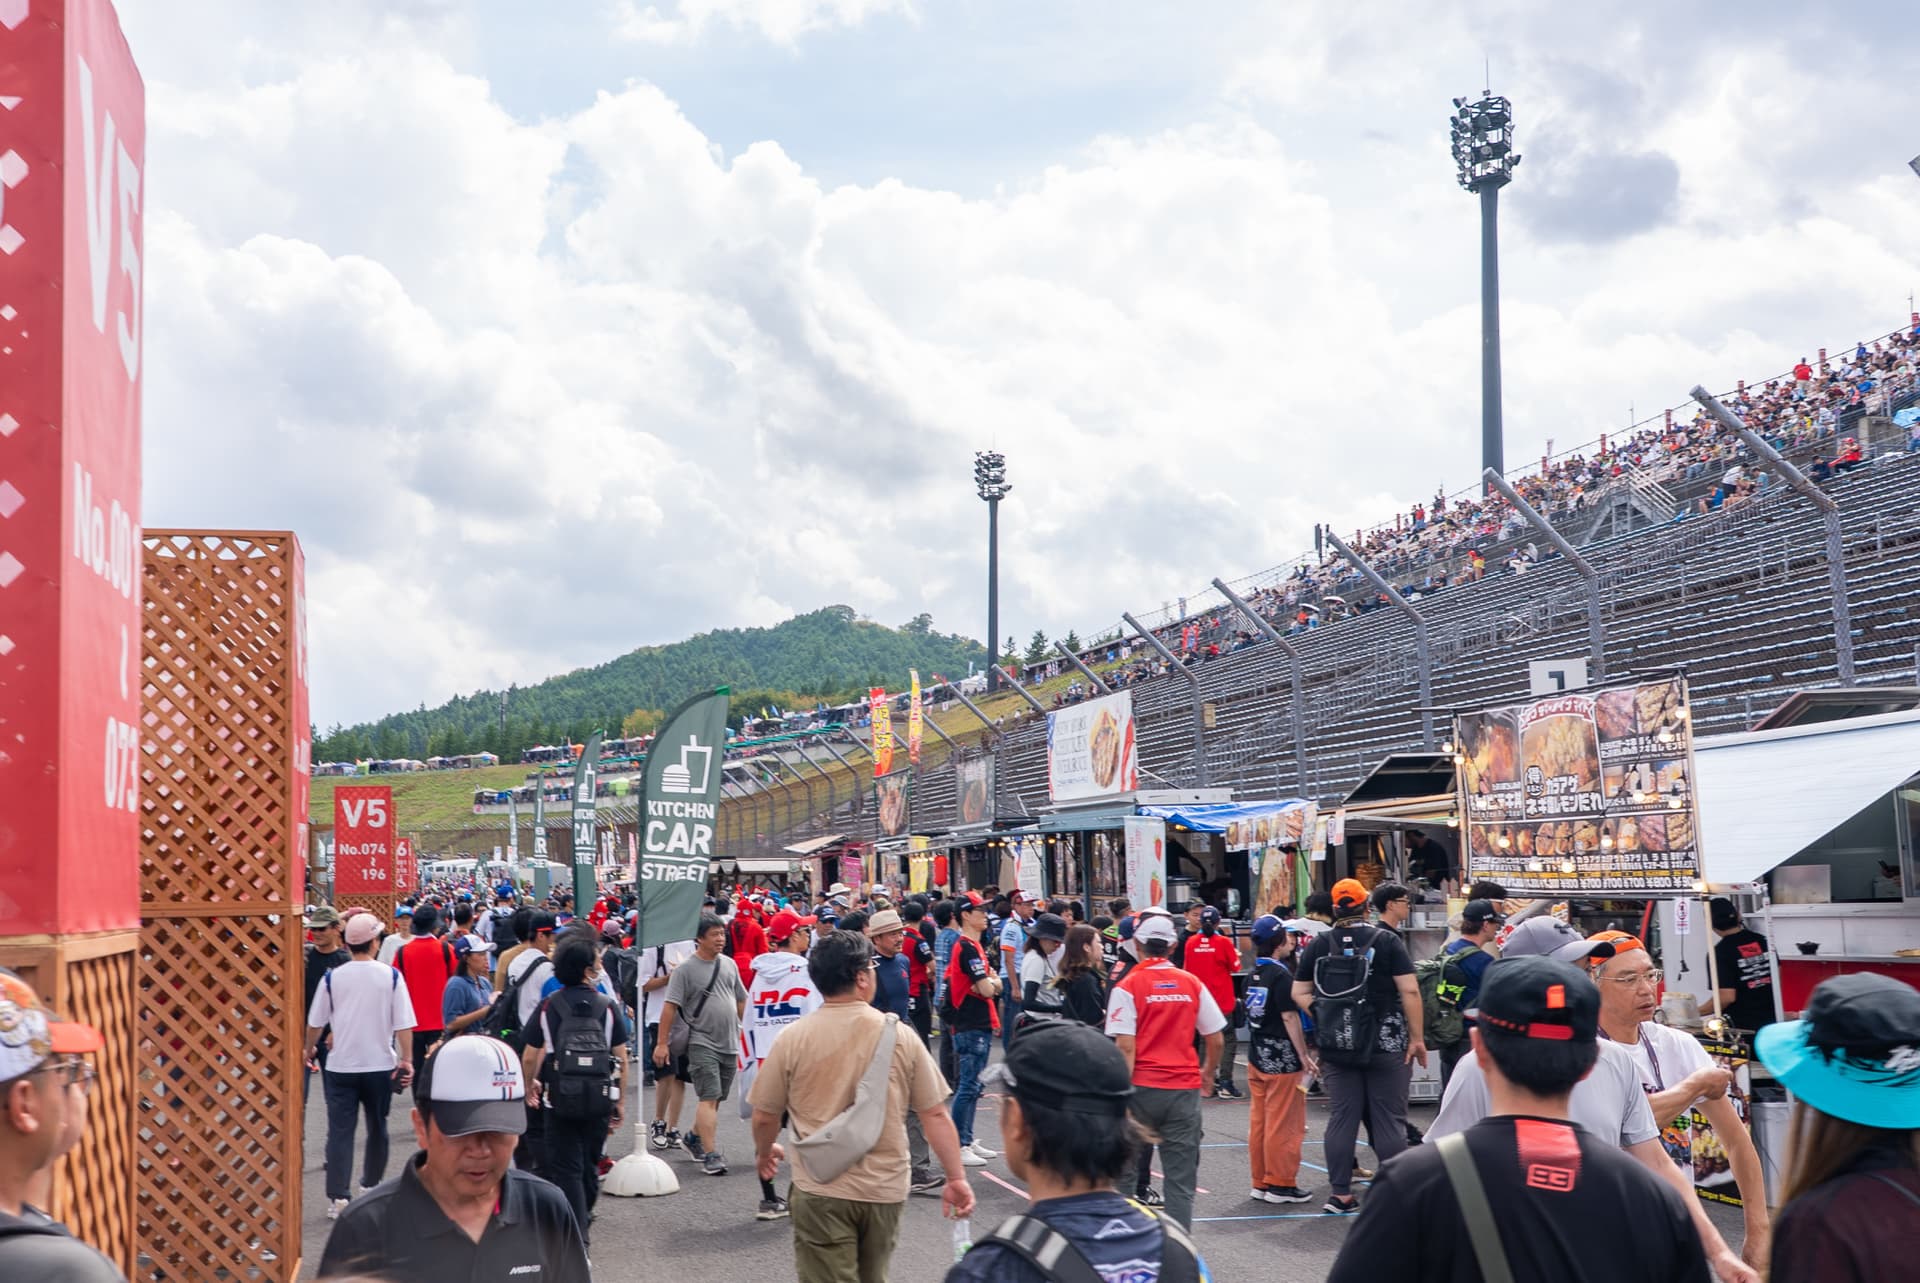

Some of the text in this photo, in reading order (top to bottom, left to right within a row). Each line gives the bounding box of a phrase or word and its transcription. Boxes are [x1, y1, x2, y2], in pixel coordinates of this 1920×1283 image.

[78, 52, 140, 383] V5
[105, 717, 139, 813] 073
[341, 798, 387, 828] V5
[647, 800, 715, 819] KITCHEN
[339, 843, 387, 856] No.074
[645, 820, 713, 855] CAR
[361, 868, 387, 881] 196
[641, 862, 708, 883] STREET
